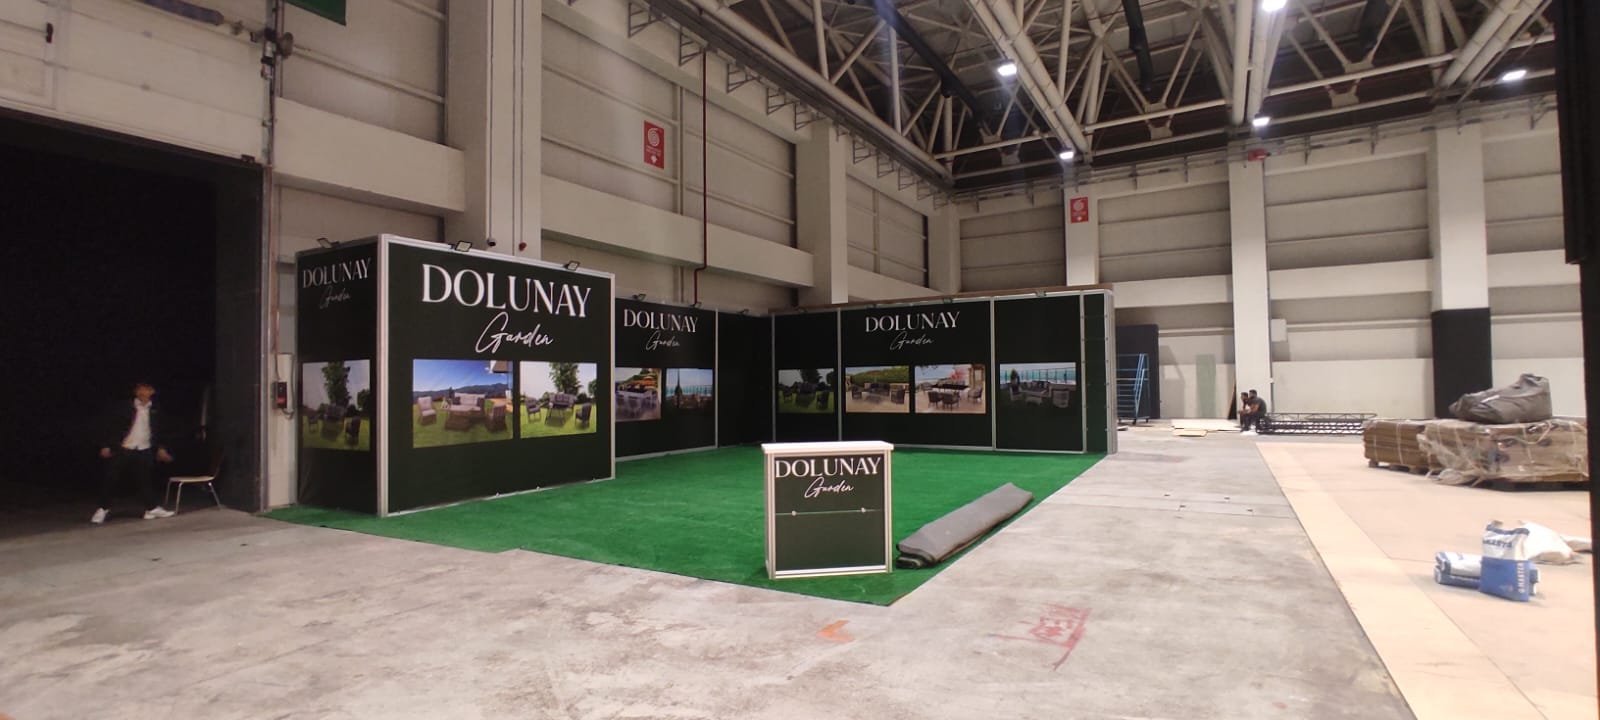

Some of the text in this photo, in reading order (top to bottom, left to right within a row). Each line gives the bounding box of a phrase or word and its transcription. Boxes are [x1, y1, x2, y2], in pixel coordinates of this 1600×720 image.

[302, 257, 371, 289] DOLUNAY
[422, 263, 592, 318] DOLUNAY
[623, 308, 698, 333] DOLUNAY
[865, 311, 960, 333] DOLUNAY
[475, 311, 554, 354] Garden
[645, 330, 681, 351] Garden
[889, 331, 934, 350] Garden
[775, 457, 881, 478] DOLUNAY
[804, 476, 855, 498] Garden
